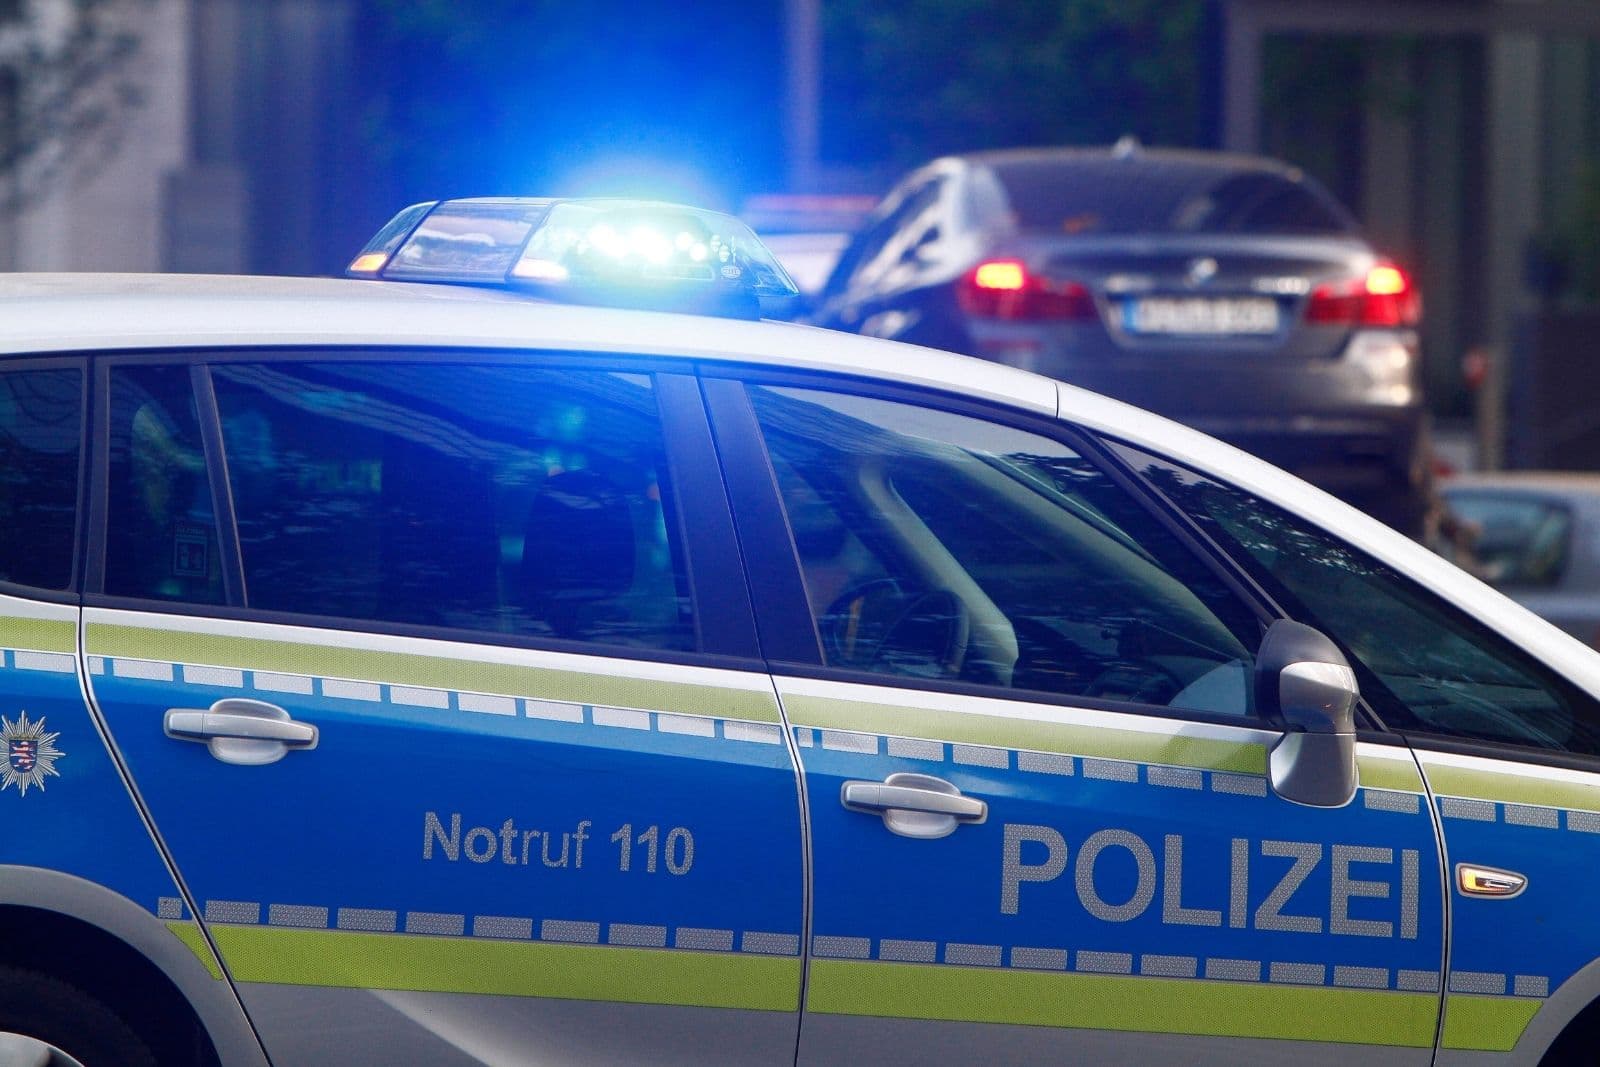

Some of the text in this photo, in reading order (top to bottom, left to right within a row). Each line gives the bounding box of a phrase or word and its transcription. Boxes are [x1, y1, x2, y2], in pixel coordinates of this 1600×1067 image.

[423, 811, 694, 876] Notruf 110
[1000, 823, 1419, 939] POLIZEI
